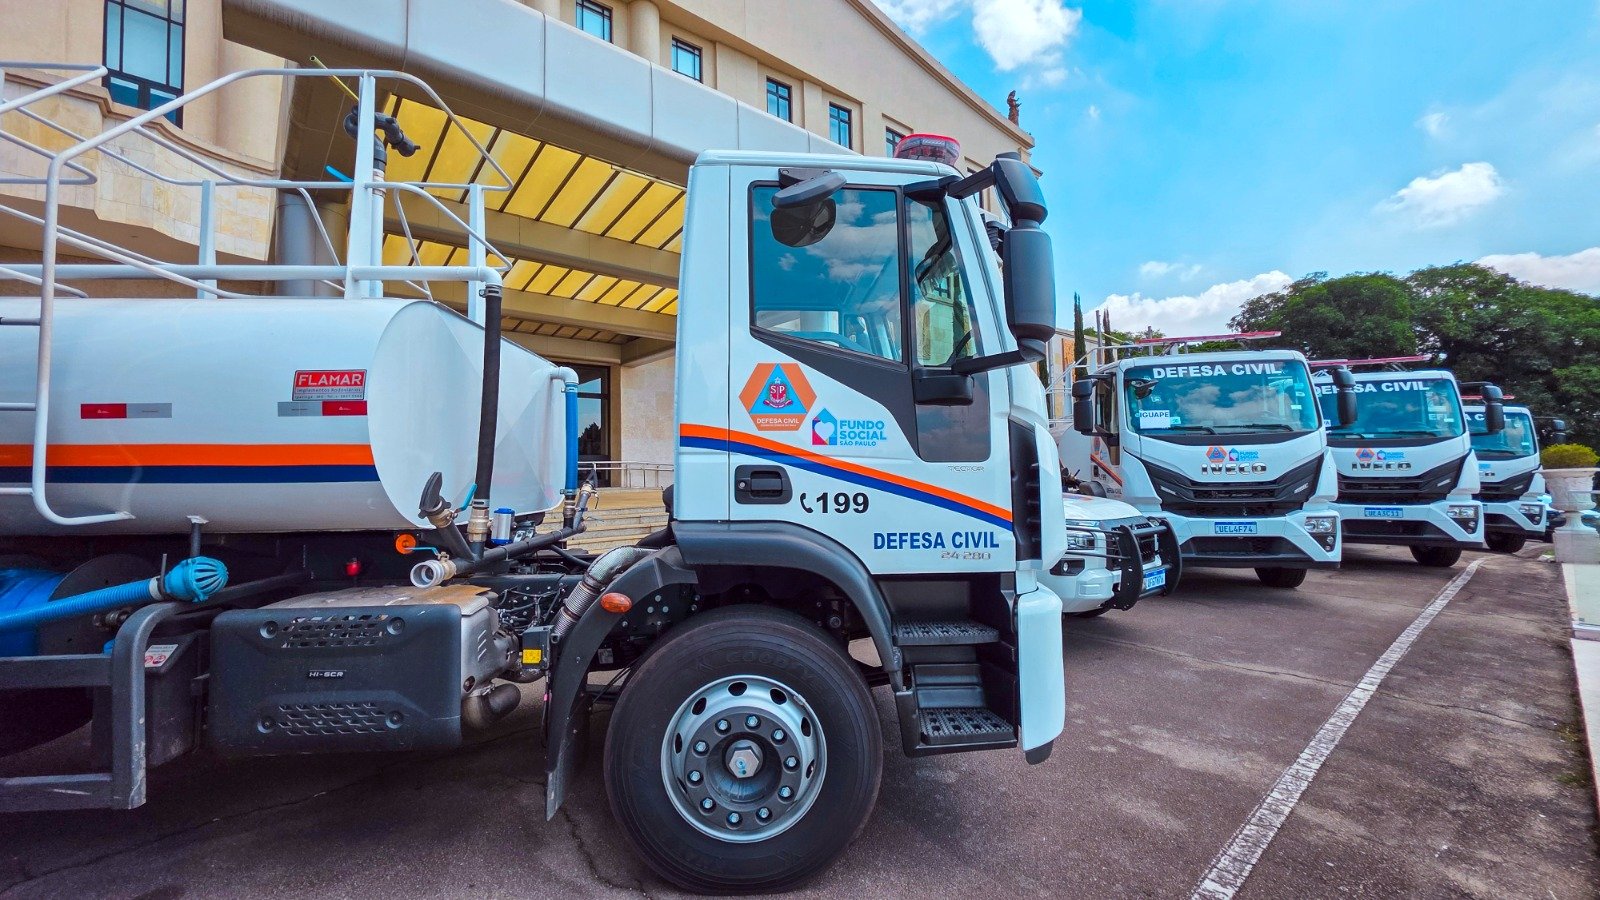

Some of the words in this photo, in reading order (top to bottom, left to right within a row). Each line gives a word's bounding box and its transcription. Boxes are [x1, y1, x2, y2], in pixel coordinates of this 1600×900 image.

[1152, 366, 1227, 379] DEFESA
[1231, 363, 1283, 376] CIVIL
[298, 374, 362, 385] FLAMAR
[1381, 381, 1430, 391] CIVIL
[839, 420, 885, 430] FUNDO
[839, 431, 887, 440] SOCIAL
[1201, 462, 1267, 475] IVECO
[1351, 461, 1412, 471] IVECO
[816, 492, 869, 513] 199
[873, 532, 946, 550] DEFESA
[951, 531, 1000, 548] CIVIL
